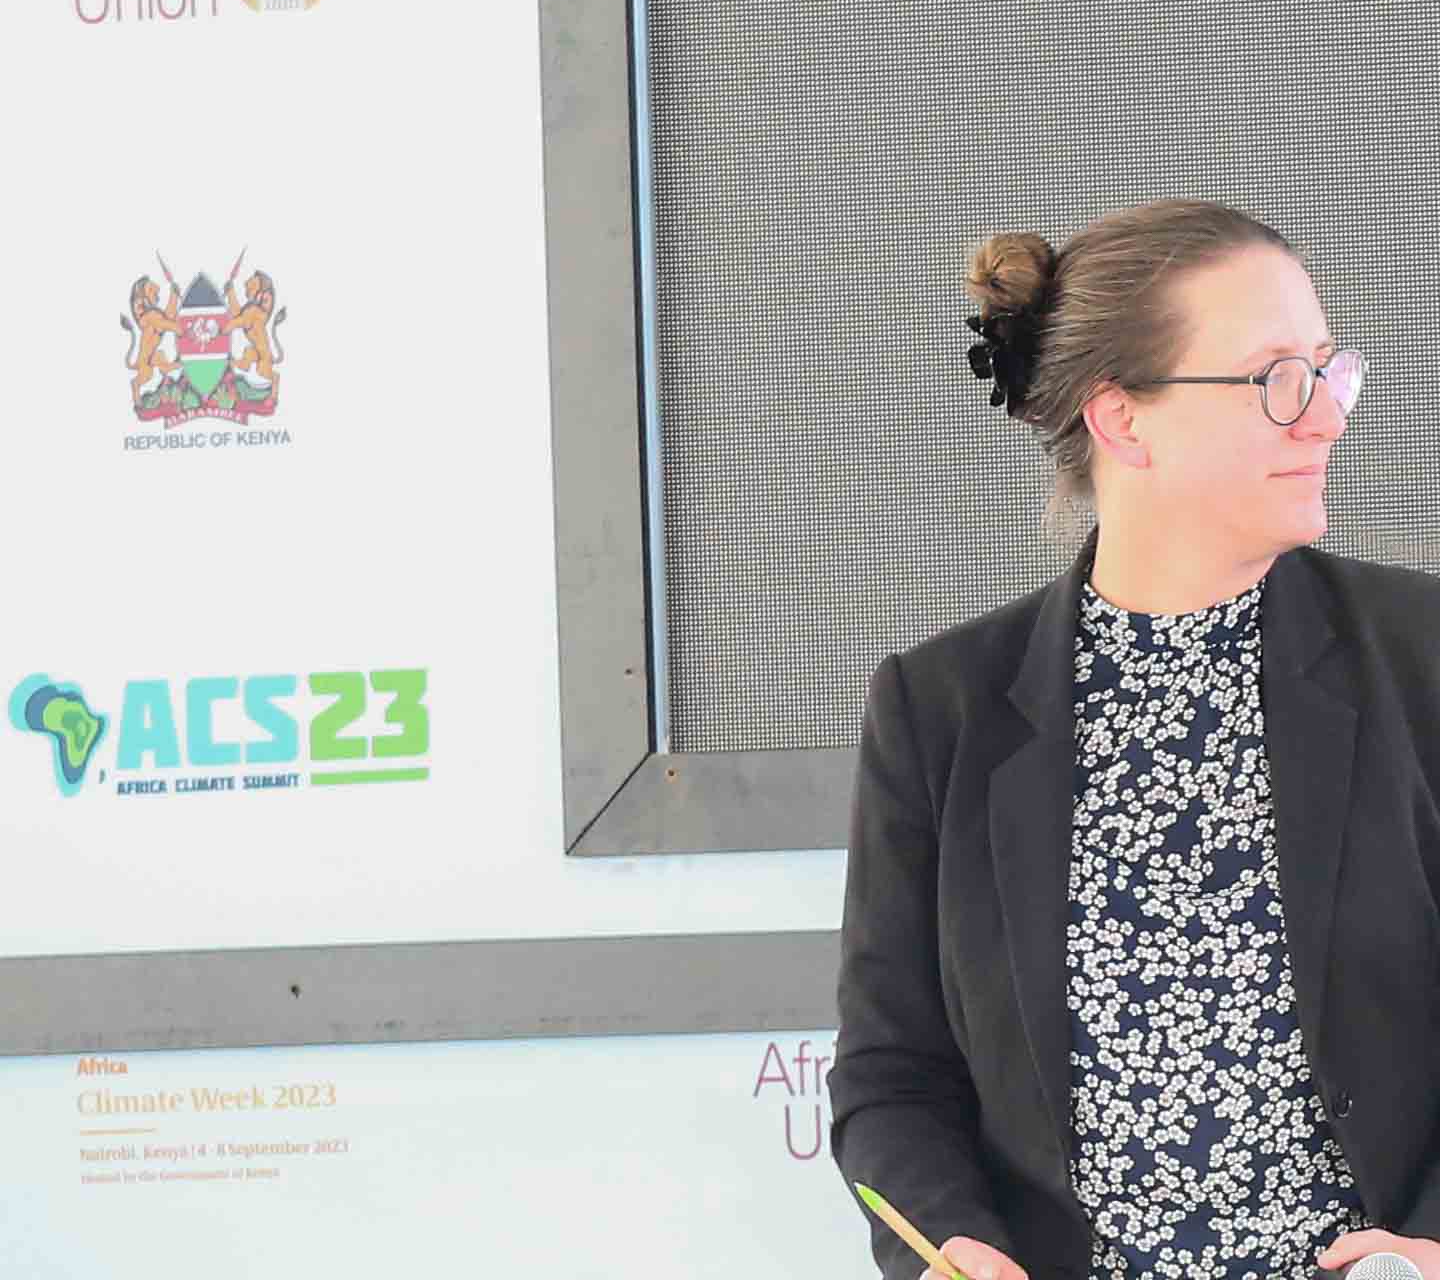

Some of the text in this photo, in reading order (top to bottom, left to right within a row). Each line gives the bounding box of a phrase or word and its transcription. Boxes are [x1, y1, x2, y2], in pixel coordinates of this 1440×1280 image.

[124, 429, 291, 450] REPUBLIC OF KENYA
[116, 668, 429, 771] ACS23
[116, 772, 299, 795] AFRICA CLIMATE SUMMIT
[77, 1057, 128, 1076] Africa
[77, 1083, 337, 1115] Climate Week 2023
[227, 1140, 310, 1161] September
